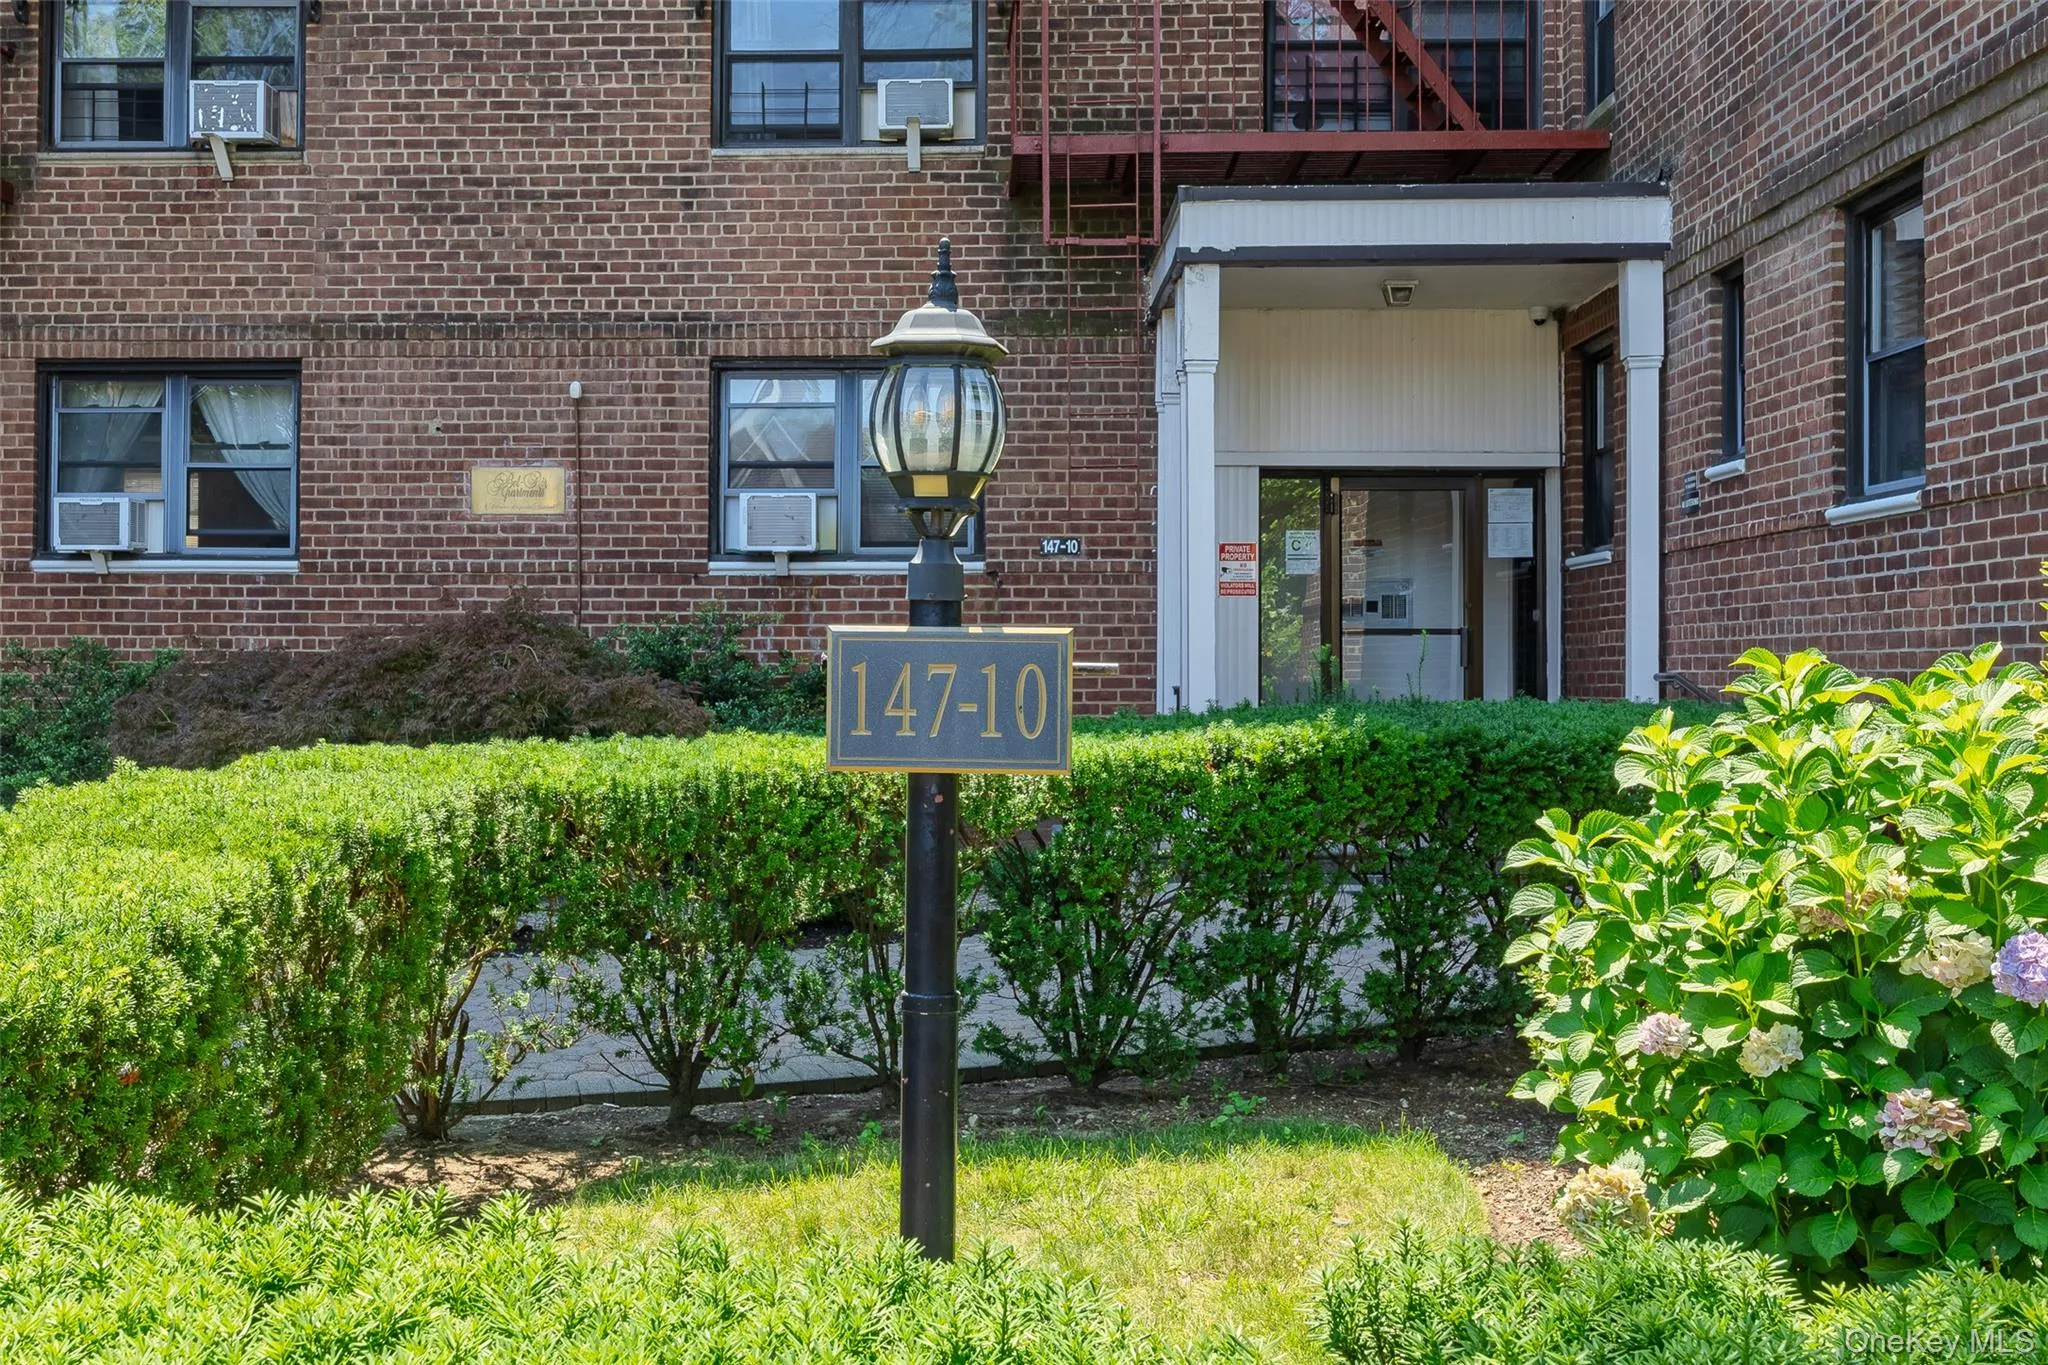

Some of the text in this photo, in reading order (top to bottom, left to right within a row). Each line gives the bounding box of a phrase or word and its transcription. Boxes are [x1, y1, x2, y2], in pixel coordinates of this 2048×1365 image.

[1042, 539, 1078, 553] 147-10
[1225, 545, 1250, 553] PRIVATE
[1291, 539, 1301, 551] C
[850, 661, 1047, 740] 147-10
